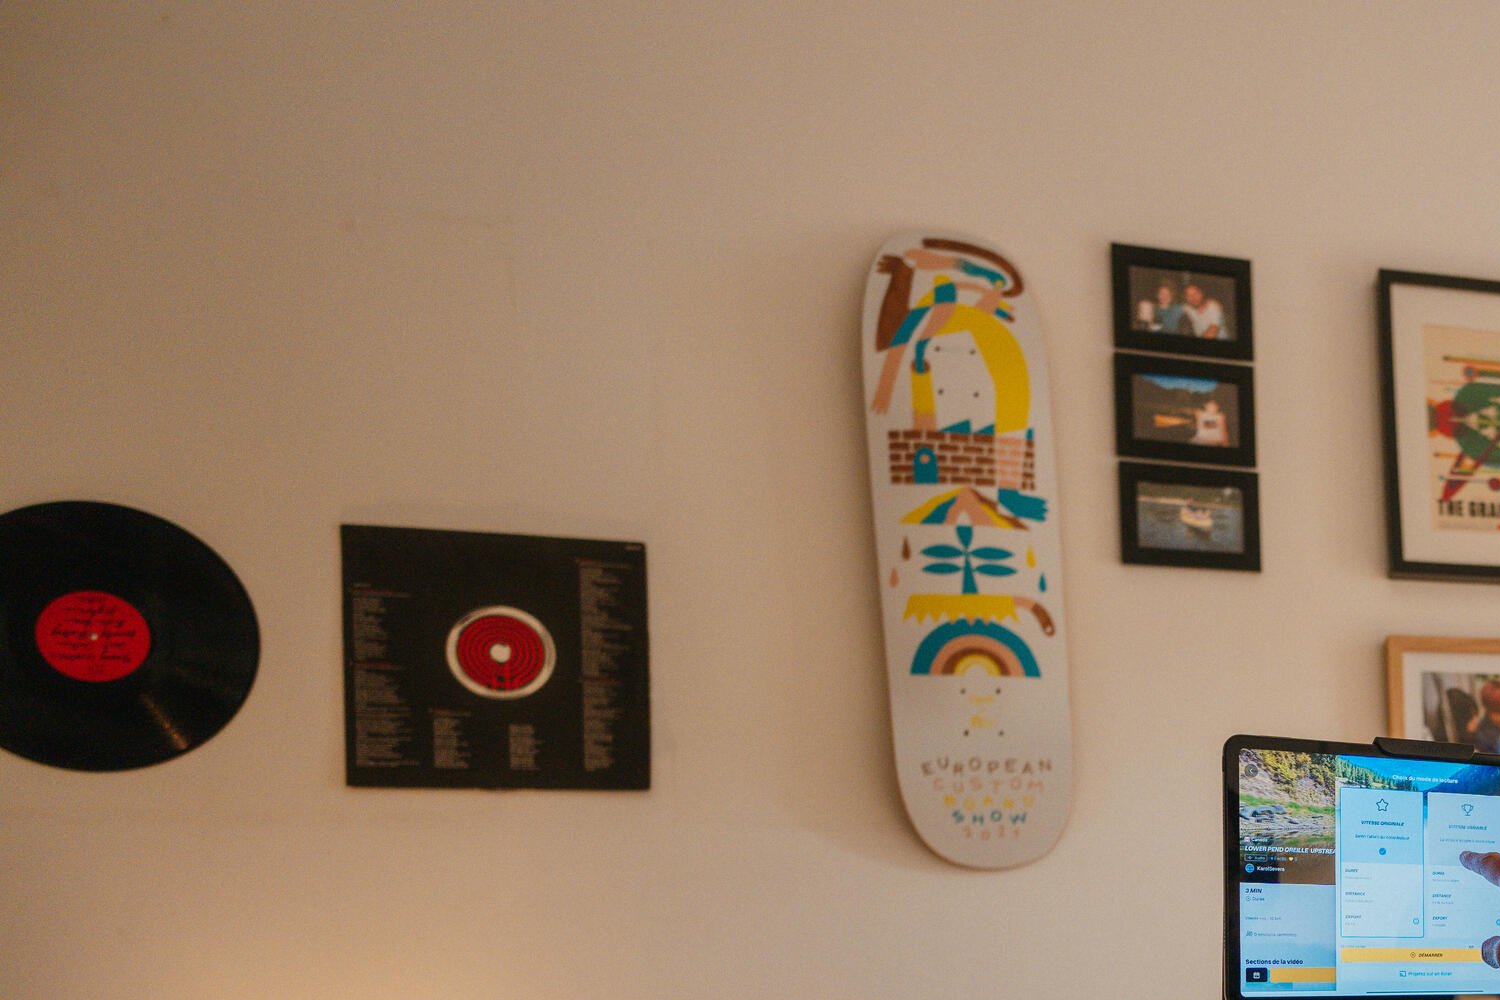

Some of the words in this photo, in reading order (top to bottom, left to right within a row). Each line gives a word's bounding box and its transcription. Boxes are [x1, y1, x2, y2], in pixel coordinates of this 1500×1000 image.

[1438, 499, 1463, 516] THE
[921, 757, 1053, 776] EUROPEAN
[933, 777, 1044, 795] CUSTOM
[944, 794, 1035, 811] BOARD
[952, 810, 1028, 824] SHOW
